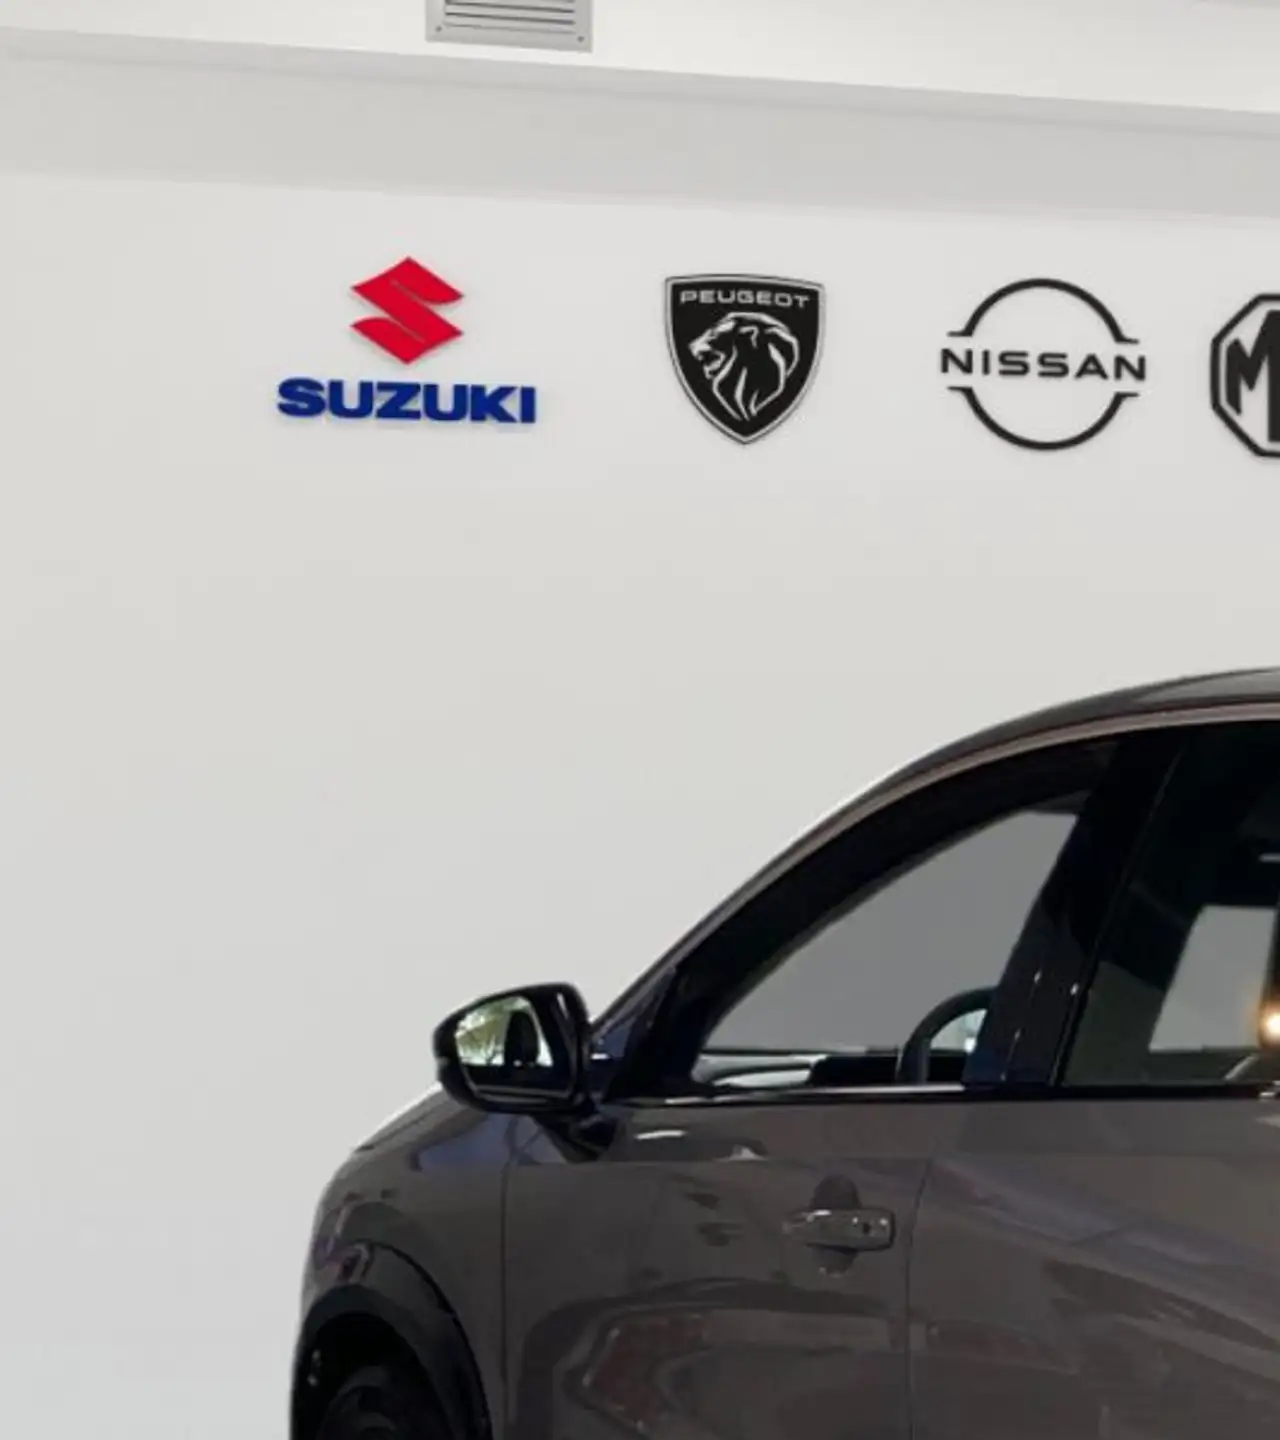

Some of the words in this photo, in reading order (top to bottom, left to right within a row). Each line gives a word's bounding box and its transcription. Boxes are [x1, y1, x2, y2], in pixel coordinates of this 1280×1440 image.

[679, 289, 810, 308] PEUGEOT
[940, 348, 1146, 382] NISSAN
[277, 377, 537, 425] SUZUKI
